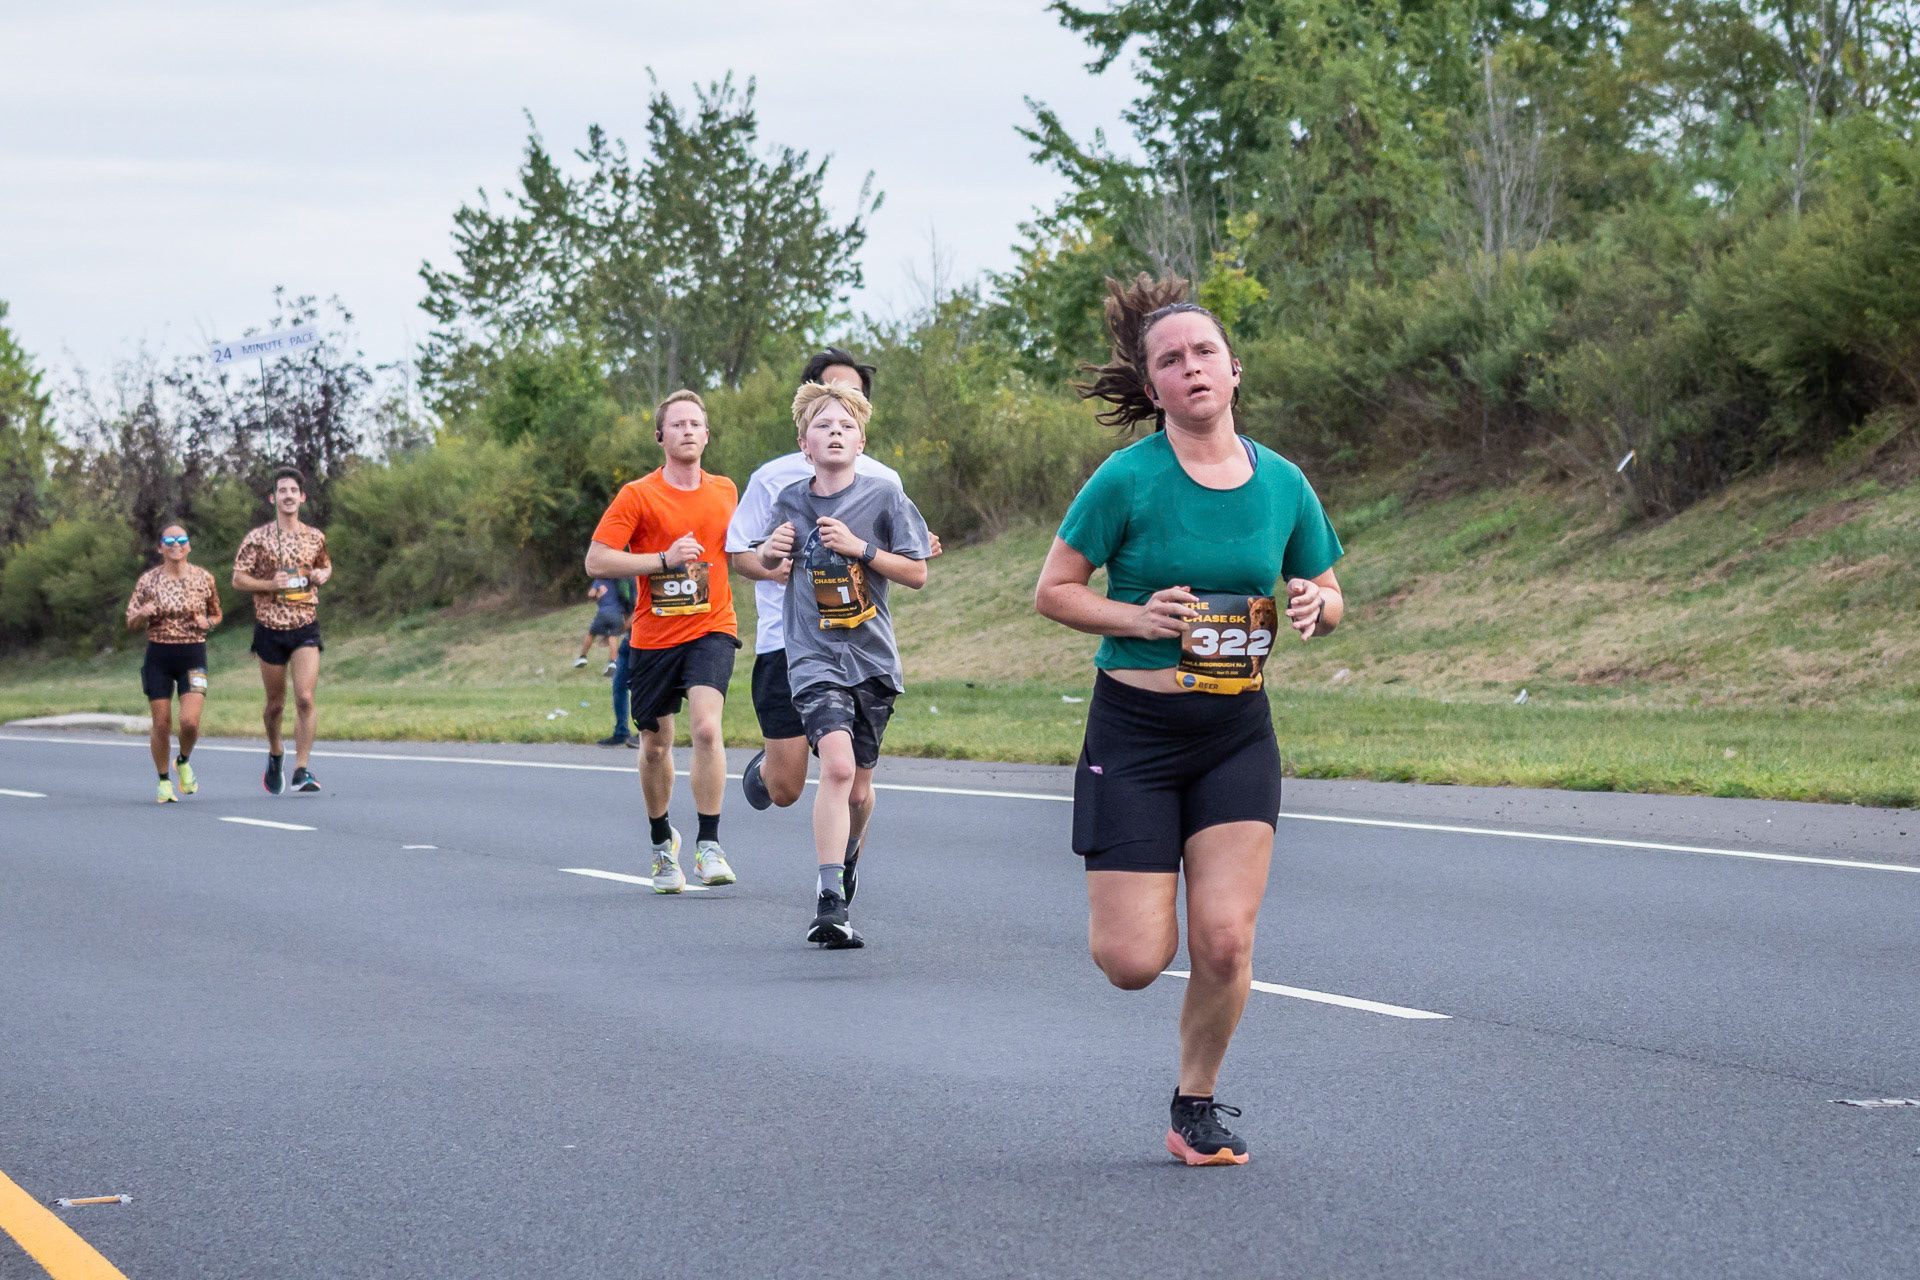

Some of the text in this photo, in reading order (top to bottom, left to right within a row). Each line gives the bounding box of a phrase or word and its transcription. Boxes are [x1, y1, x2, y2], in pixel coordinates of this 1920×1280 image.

[213, 332, 314, 363] 24 MINUTE PACE
[663, 579, 698, 596] 90
[837, 586, 850, 604] 1
[1229, 615, 1246, 623] 5K
[1191, 628, 1272, 656] 322
